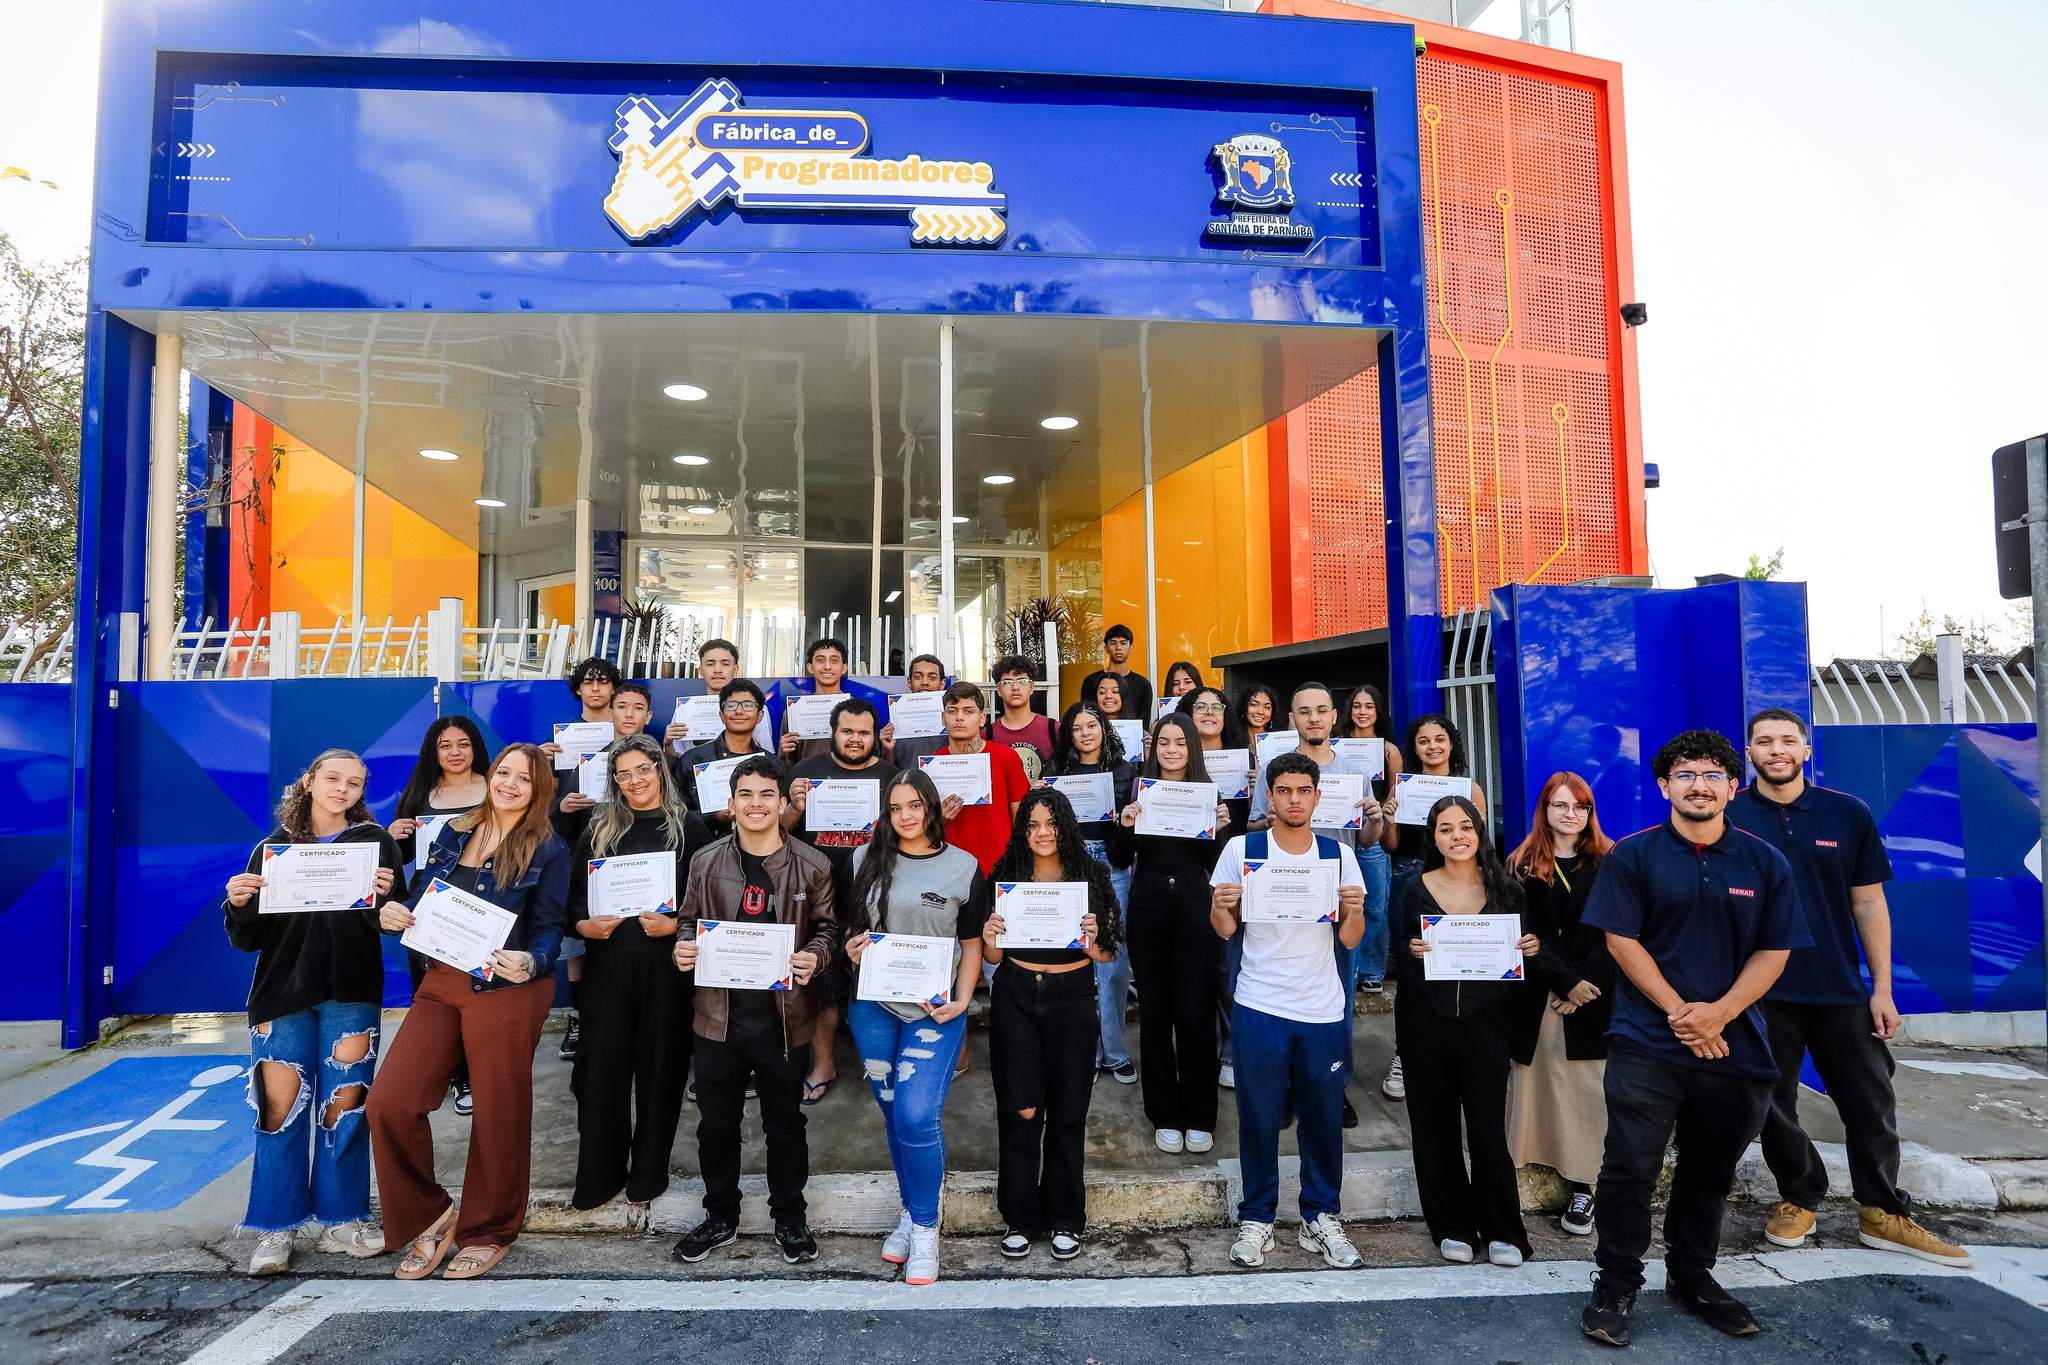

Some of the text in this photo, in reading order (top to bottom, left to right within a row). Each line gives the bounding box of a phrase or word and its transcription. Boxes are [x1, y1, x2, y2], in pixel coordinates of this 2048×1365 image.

[743, 156, 992, 185] Programadores
[1233, 214, 1288, 224] PREFEITURA DE
[1208, 222, 1250, 234] SANTANA
[1253, 224, 1265, 235] DE
[596, 577, 617, 591] 100
[1011, 741, 1037, 752] ATFORM
[1161, 786, 1194, 794] CERTIFICADO
[1816, 840, 1837, 848] SENAI
[612, 860, 648, 868] CERTIFICADO
[1730, 888, 1753, 897] SENAI
[451, 896, 486, 916] CERTIFICADO
[726, 929, 765, 937] CERTIFICADO
[891, 941, 928, 950] CERTIFICADO
